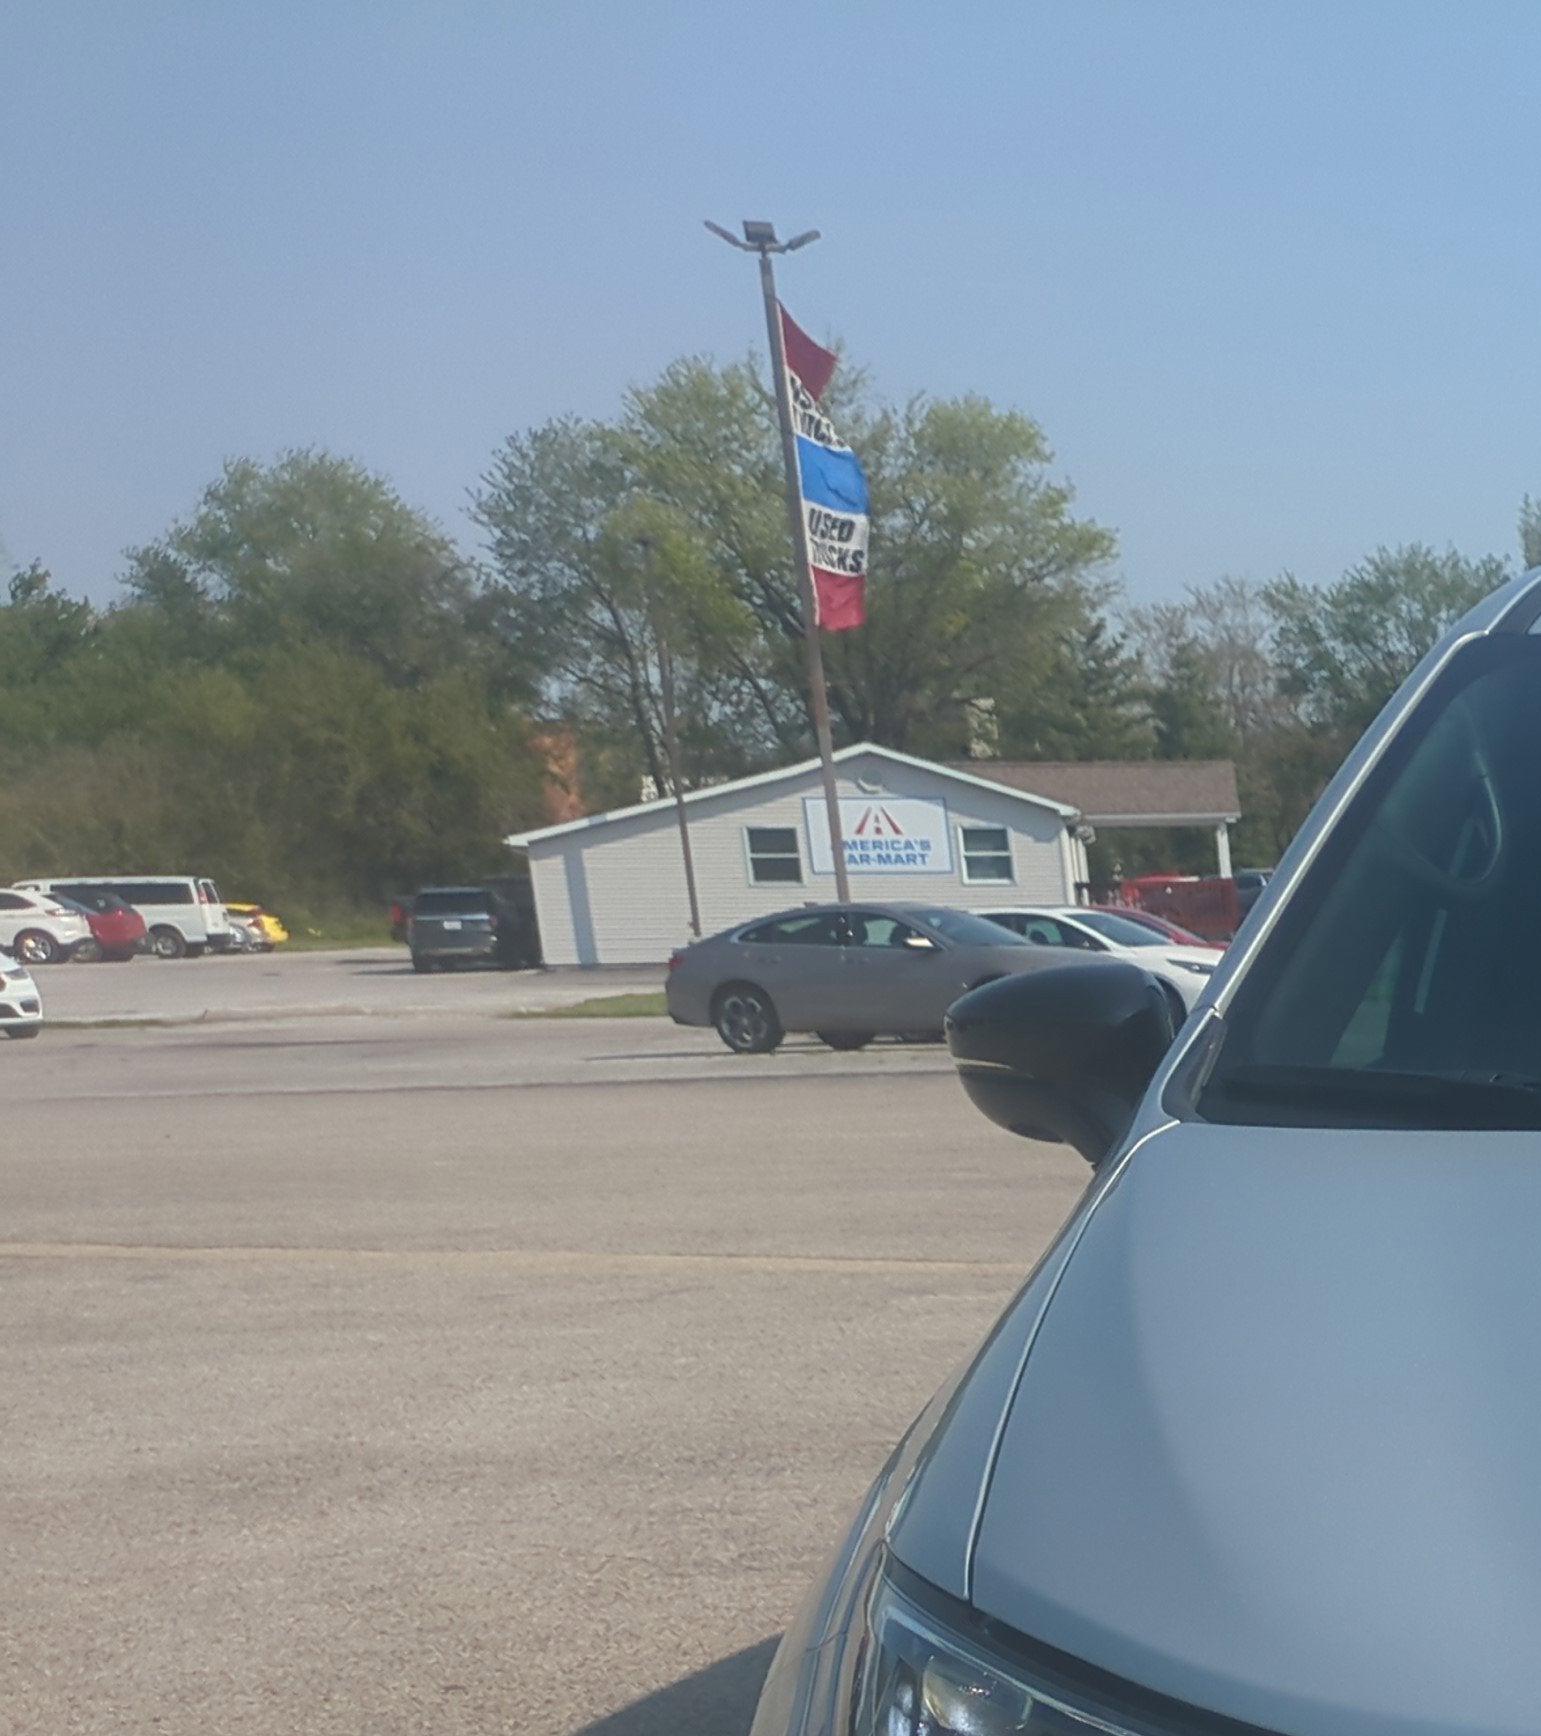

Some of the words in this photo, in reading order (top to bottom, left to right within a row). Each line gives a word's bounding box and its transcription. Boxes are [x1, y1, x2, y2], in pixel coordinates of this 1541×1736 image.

[808, 508, 856, 543] USED
[842, 839, 931, 851] MERICA'S
[847, 853, 928, 865] AR-MART
